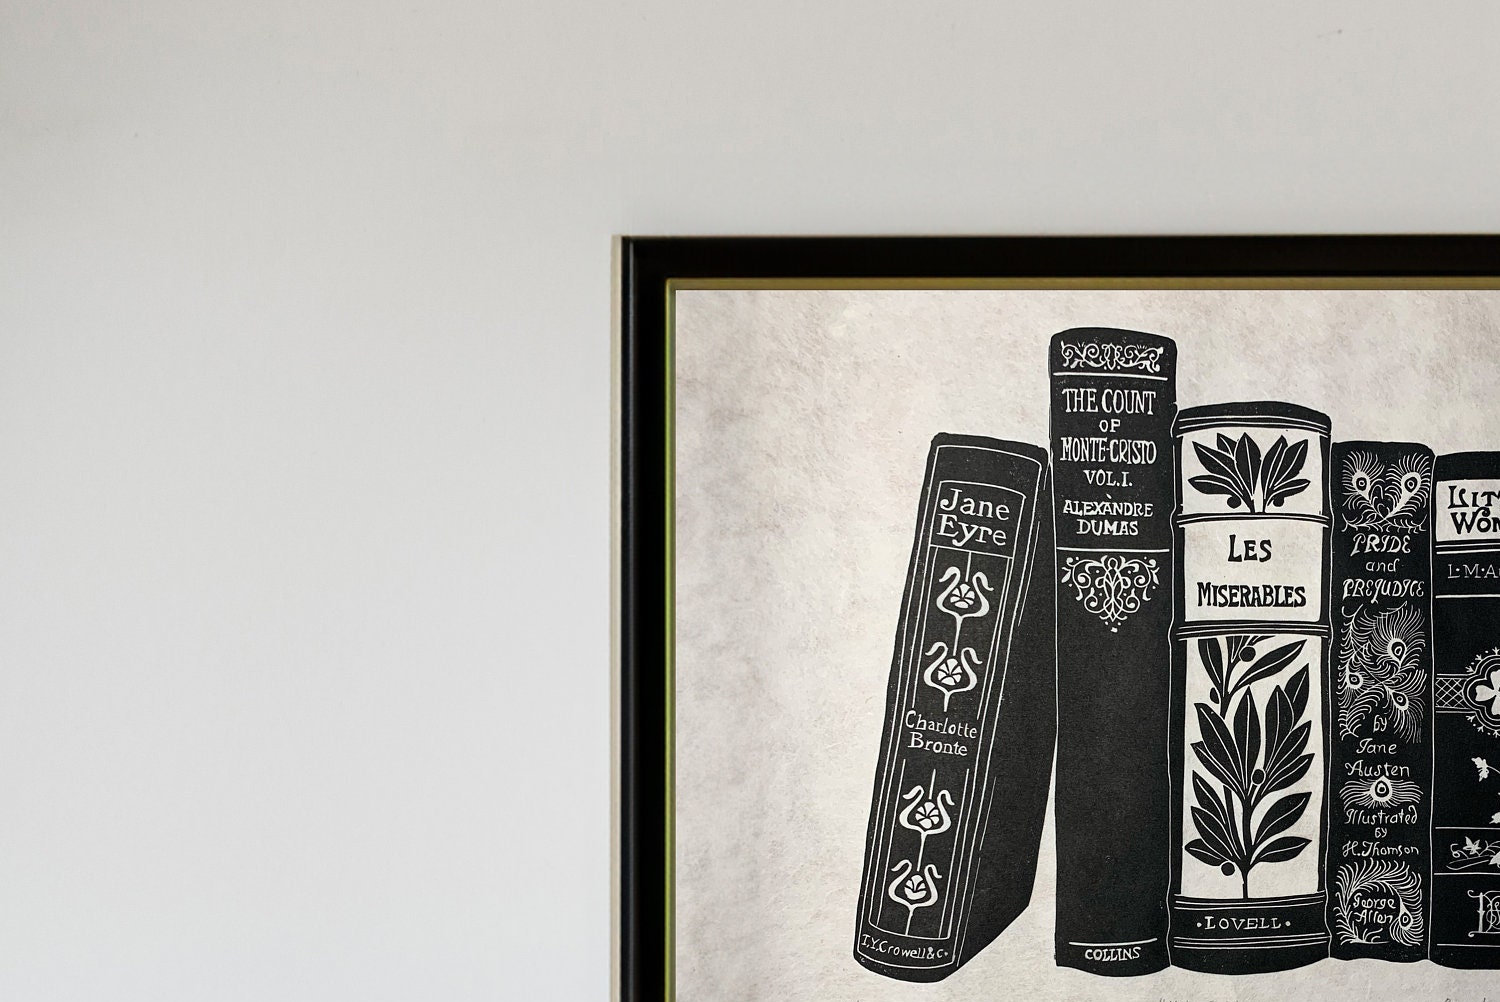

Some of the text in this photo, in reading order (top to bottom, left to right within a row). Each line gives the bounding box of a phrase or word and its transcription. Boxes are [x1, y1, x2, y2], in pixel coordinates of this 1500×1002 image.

[1062, 388, 1156, 415] THE COUNT
[1099, 419, 1121, 433] OF
[1060, 437, 1157, 465] MONTE-CRISTO
[939, 488, 1010, 520] Jane
[936, 513, 1007, 547] Eyre
[1076, 519, 1138, 536] DUMAS
[1227, 534, 1272, 562] LES
[1350, 533, 1411, 557] PRIDE
[1365, 558, 1400, 572] and
[1197, 582, 1307, 608] MISERABLES
[1342, 578, 1424, 604] PREJUDICE
[905, 710, 977, 738] Charlotte
[1373, 714, 1388, 733] by
[907, 731, 968, 756] Bronte
[1356, 738, 1397, 754] Jane
[1344, 760, 1410, 777] Austen
[1344, 805, 1418, 825] Illustrated
[1374, 827, 1387, 838] by
[1353, 892, 1396, 909] George
[1353, 909, 1394, 925] Allen
[1084, 946, 1141, 961] COLLINS
